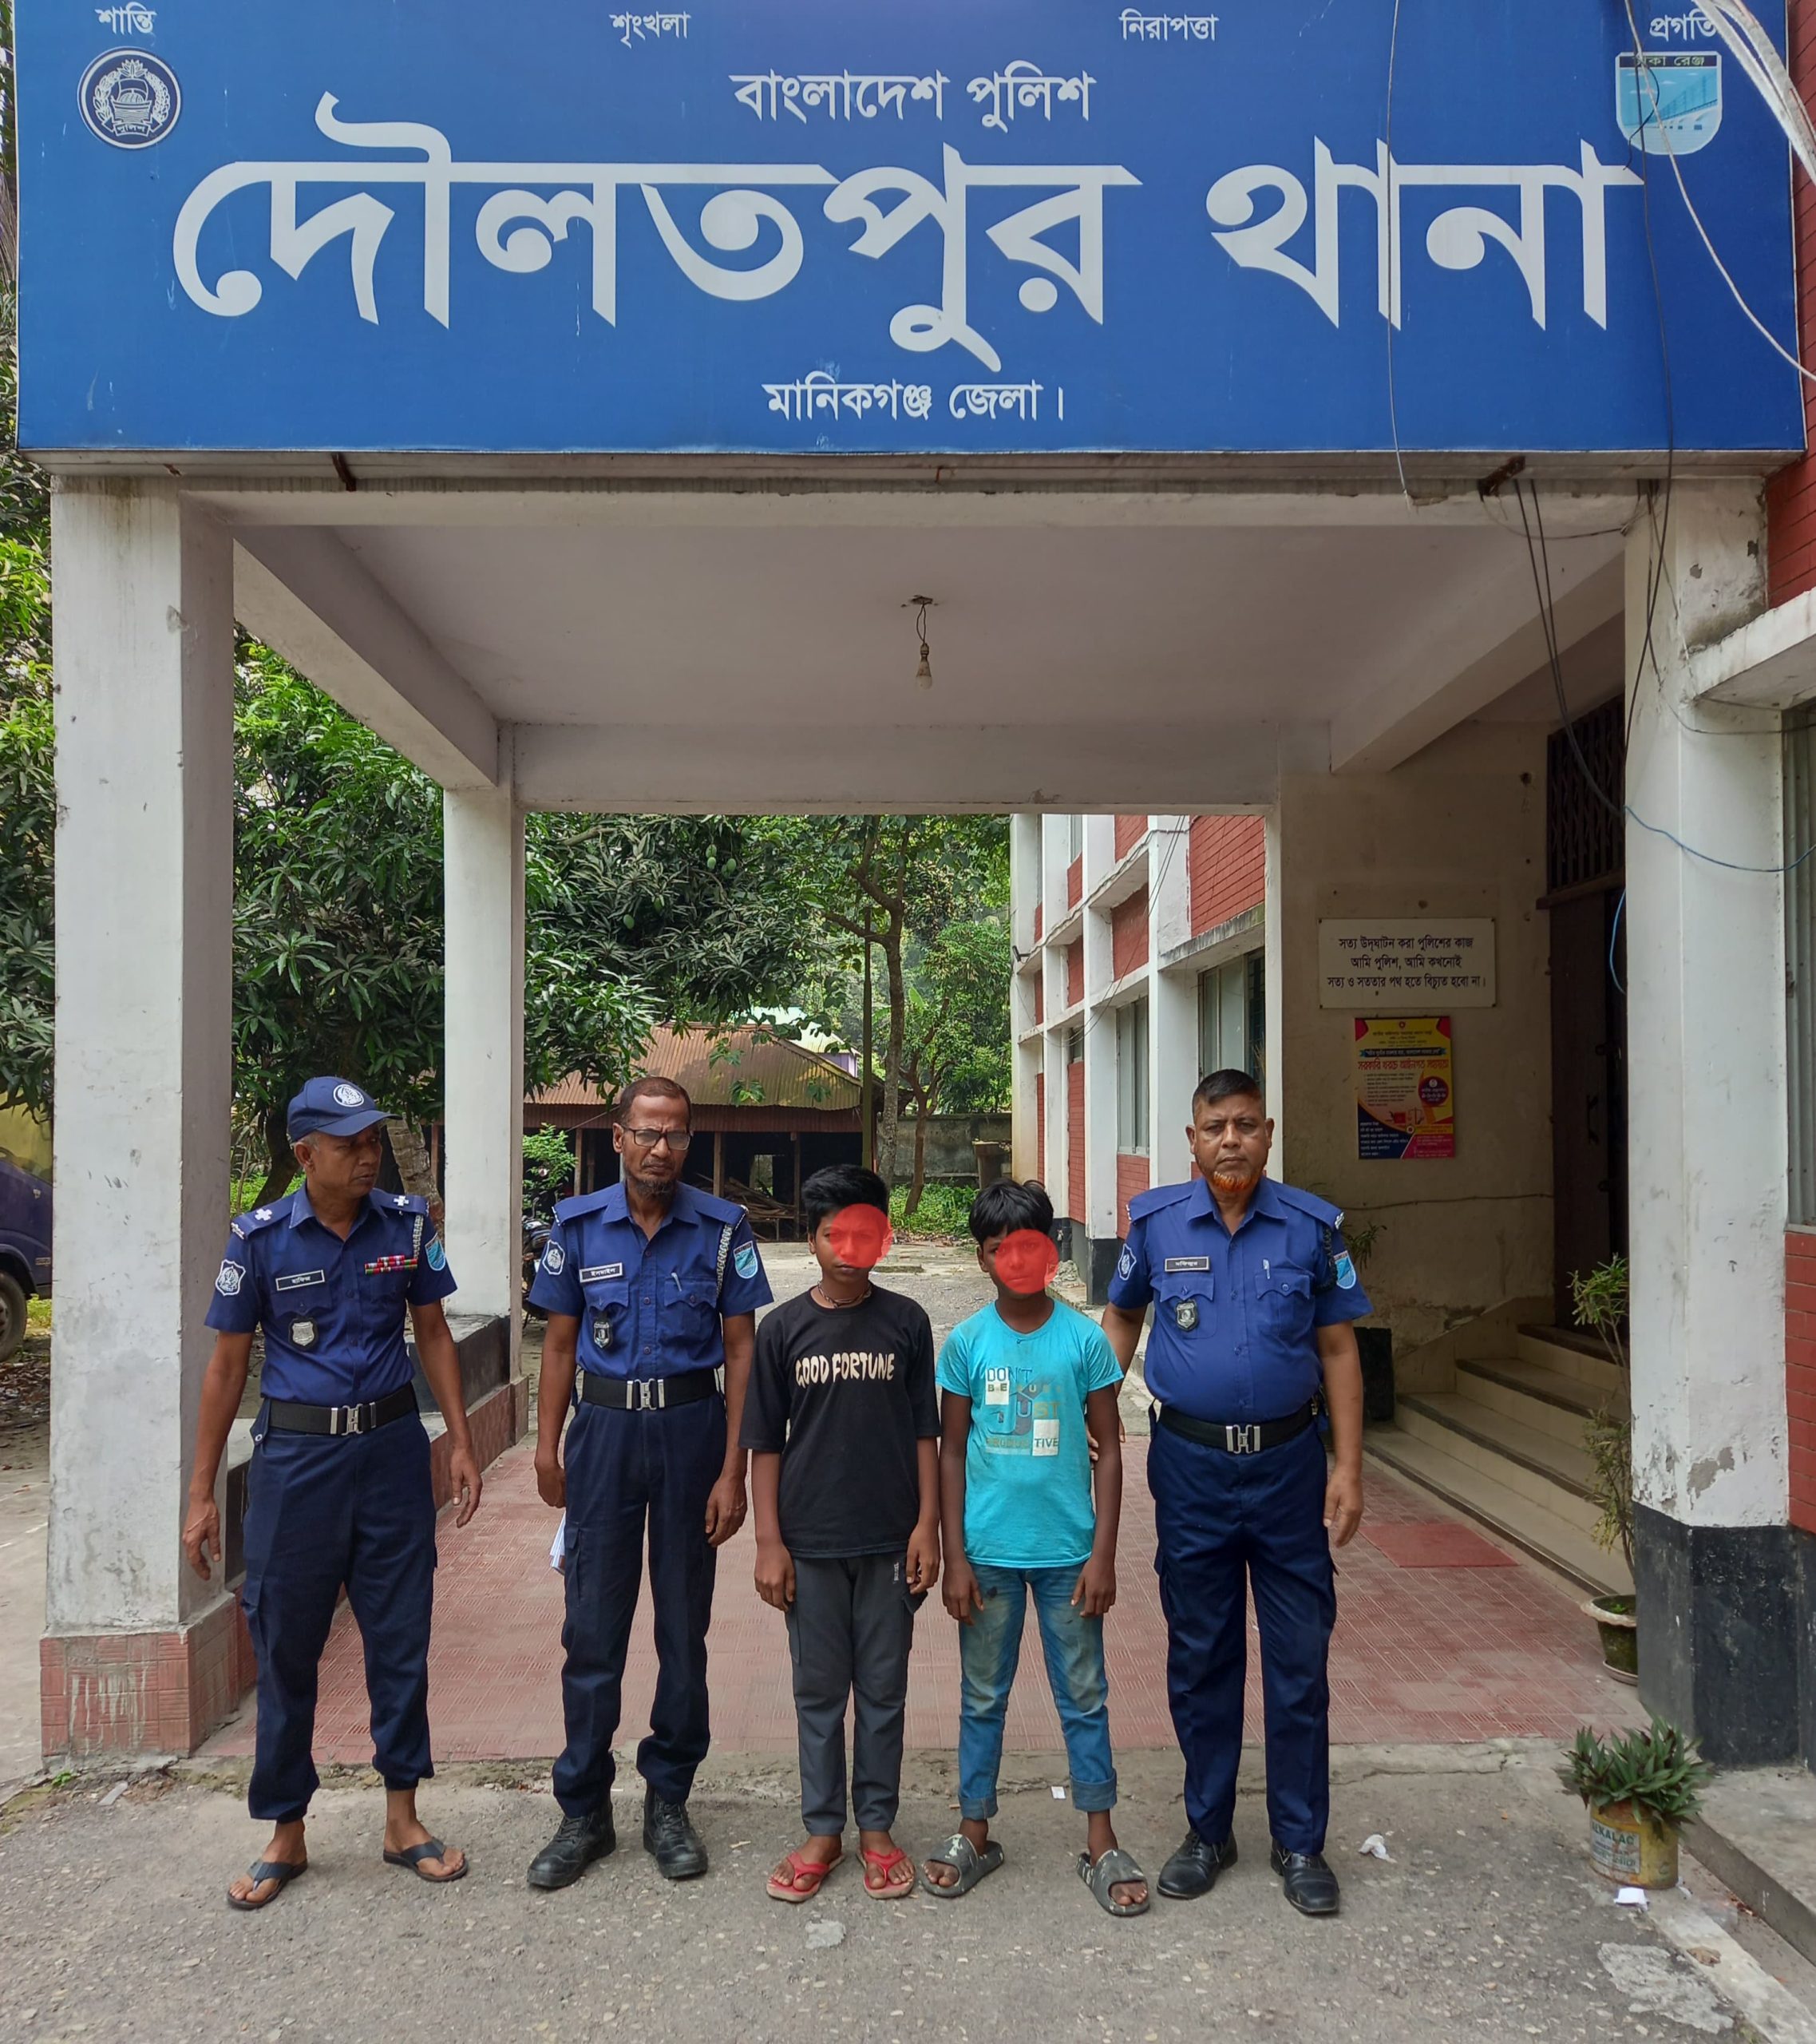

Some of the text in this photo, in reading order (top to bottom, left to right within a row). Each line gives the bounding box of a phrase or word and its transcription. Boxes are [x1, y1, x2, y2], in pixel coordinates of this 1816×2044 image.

[96, 2, 156, 34] শান্তি
[609, 11, 691, 48] শৃংখলা
[1119, 8, 1219, 40] নিরাপত্তা
[1649, 7, 1718, 42] প্রগতি
[729, 60, 1097, 133] বাংলাদেশ পুলিশ
[173, 90, 1645, 373] দৌলতপুর থানা
[762, 371, 932, 420] মানিকগঞ্জ
[1339, 937, 1357, 950] সত্য
[1398, 937, 1414, 949] করা
[1418, 934, 1451, 951] পুলিশের
[1454, 937, 1474, 949] কাজ
[1351, 954, 1462, 970] আমি পুলিশ, আমি কখনোই
[1327, 976, 1345, 988] সত্য
[1347, 979, 1355, 988] ও
[1357, 976, 1386, 989] সততার
[1389, 976, 1402, 988] পথ
[1404, 976, 1422, 988] হতে
[1424, 973, 1448, 992] বিচ্যুত
[1450, 976, 1469, 988] হবো
[795, 1352, 895, 1388] GOOD FORTUNE
[987, 1366, 1033, 1383] DON'T
